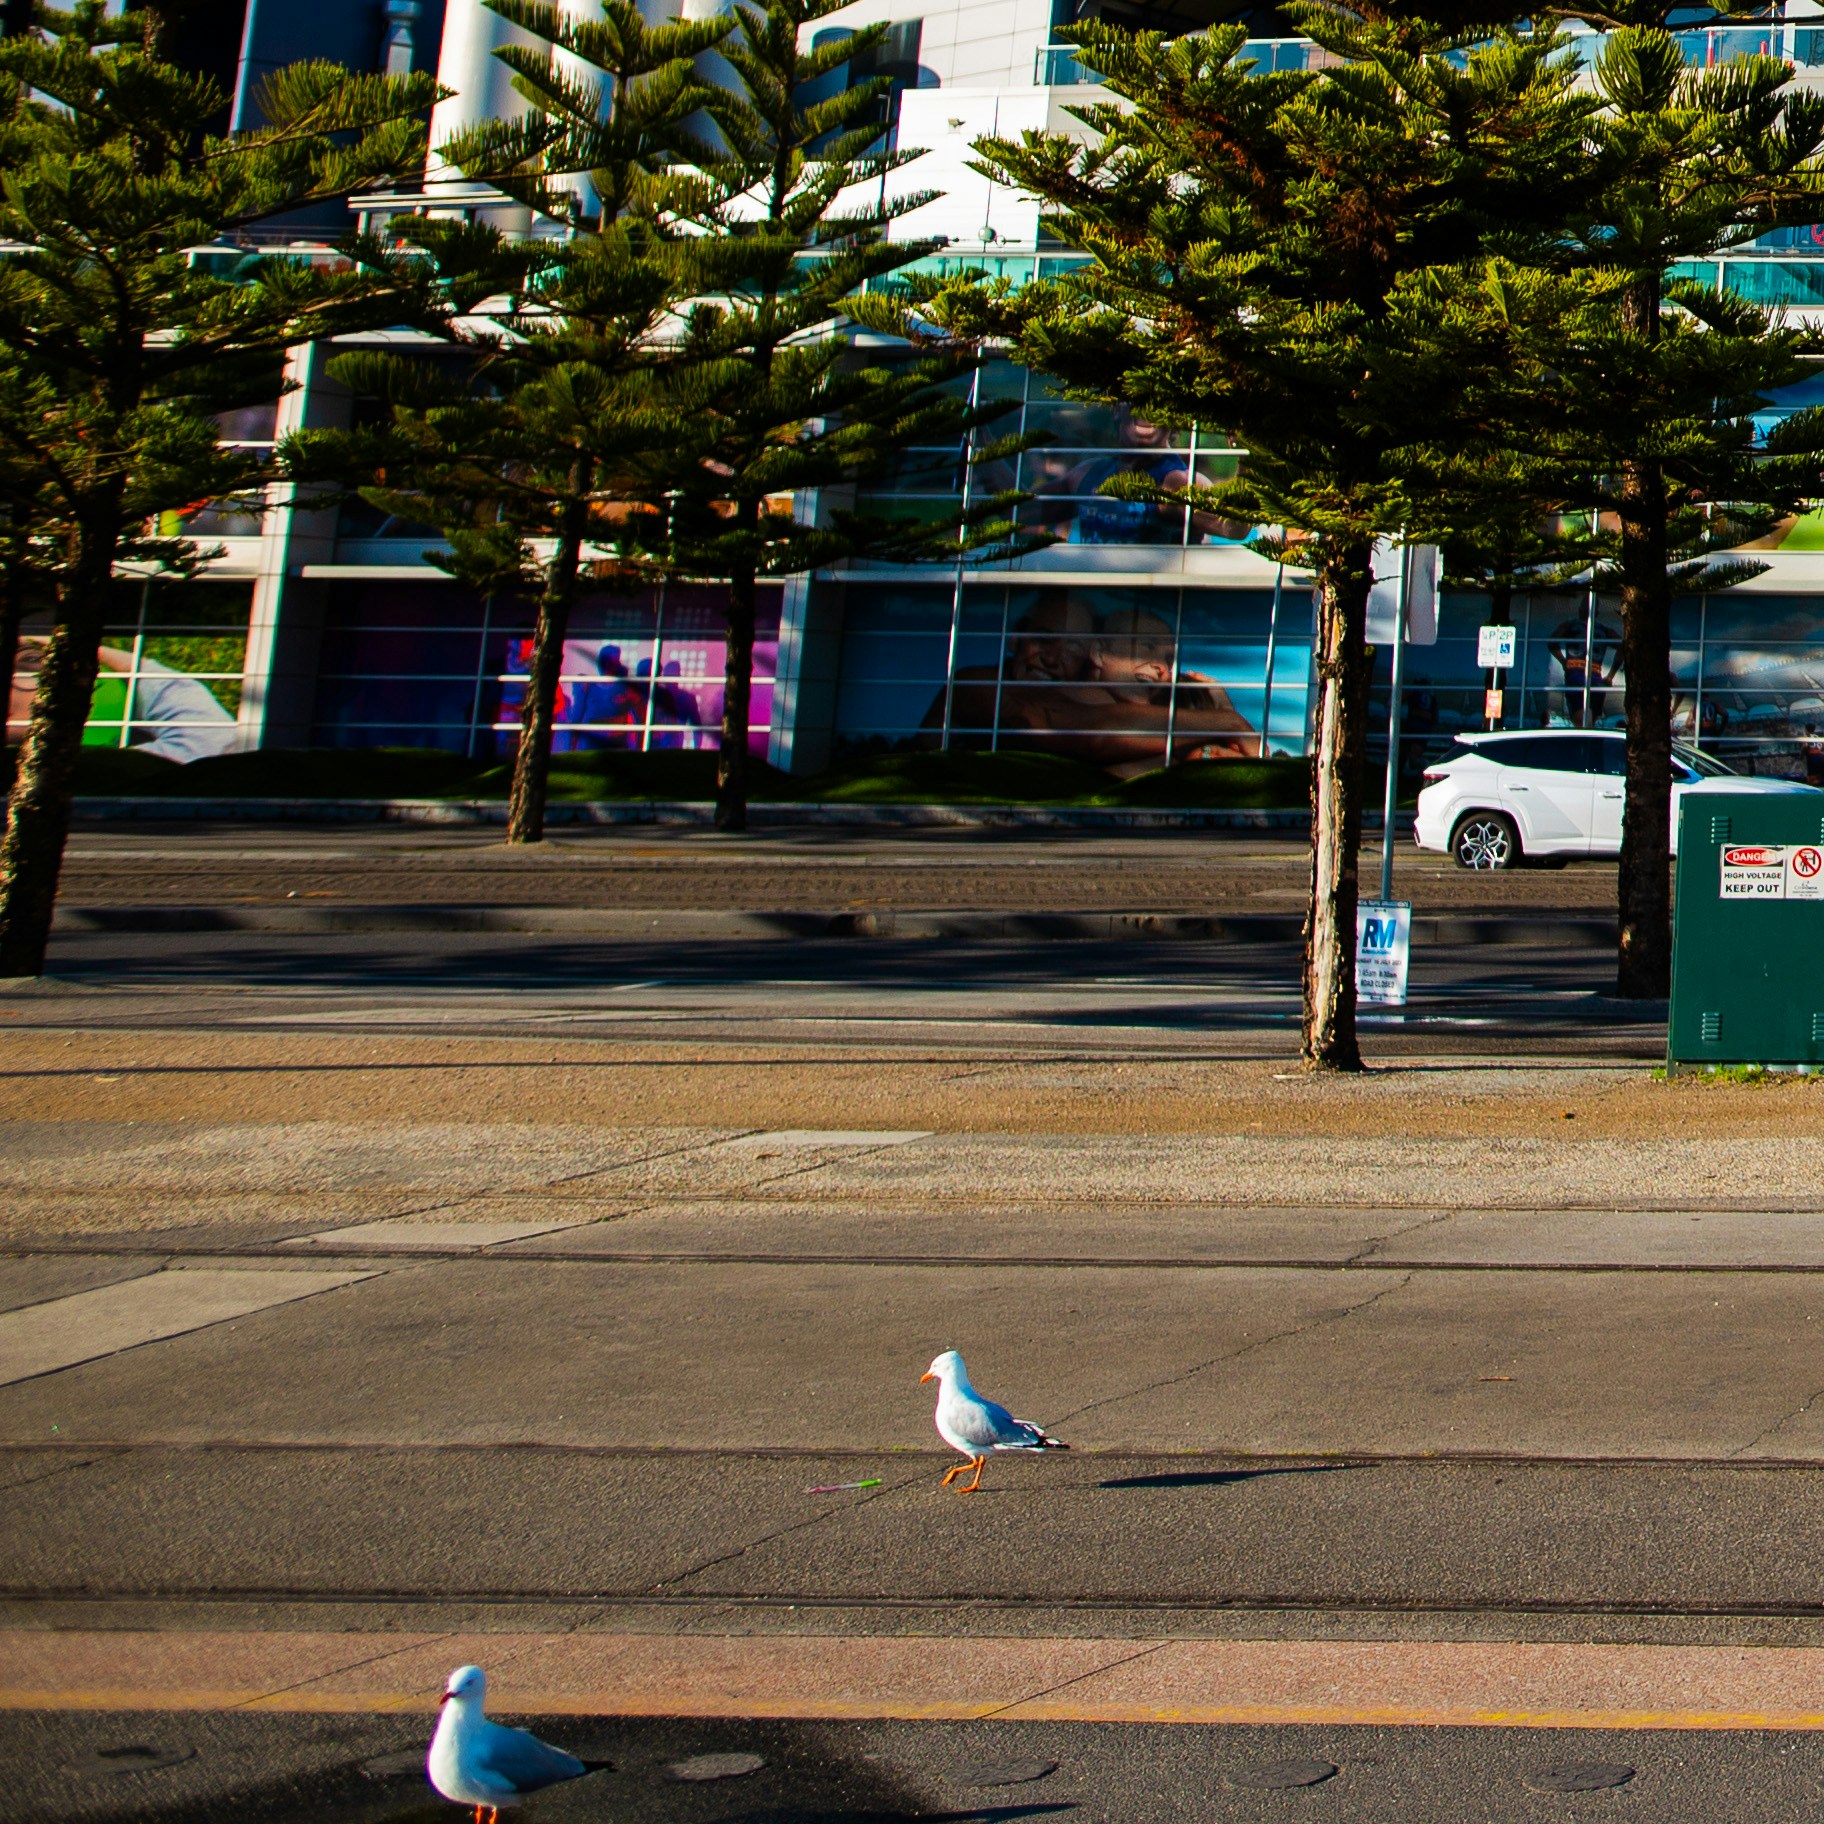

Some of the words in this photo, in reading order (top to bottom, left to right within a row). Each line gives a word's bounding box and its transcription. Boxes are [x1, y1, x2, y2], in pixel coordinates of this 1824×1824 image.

[1732, 851, 1777, 862] DANGE
[1725, 884, 1754, 893] KEEP
[1757, 884, 1780, 893] OUT
